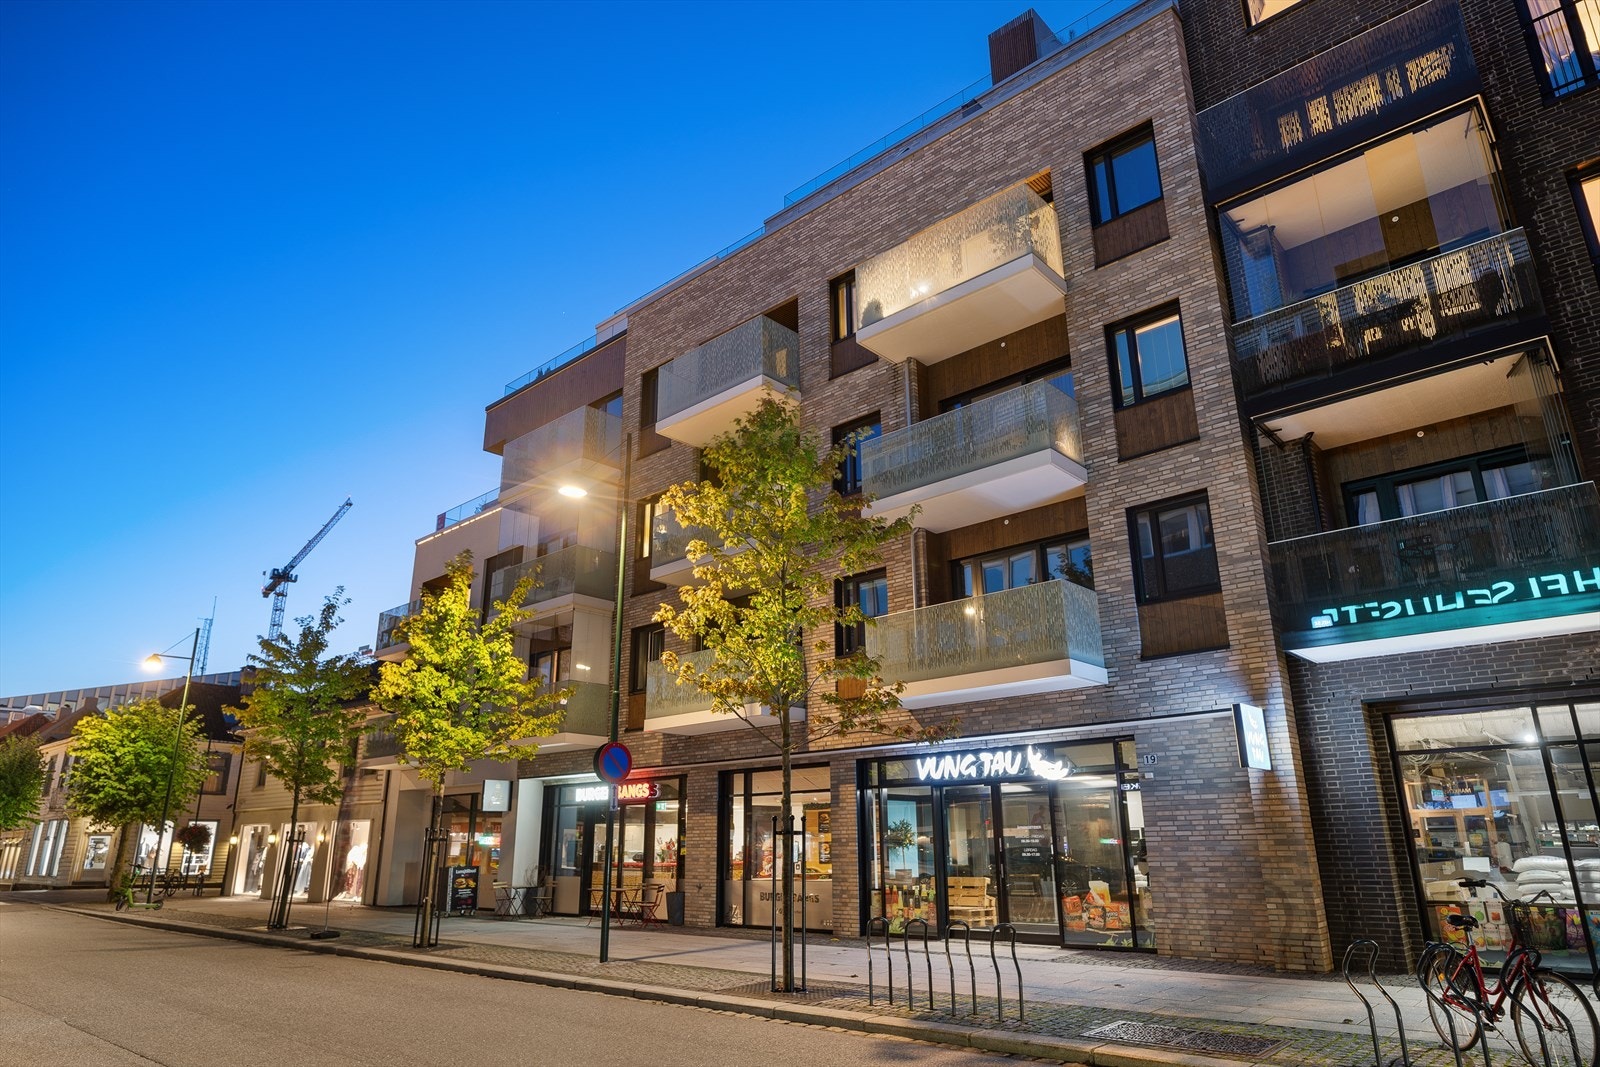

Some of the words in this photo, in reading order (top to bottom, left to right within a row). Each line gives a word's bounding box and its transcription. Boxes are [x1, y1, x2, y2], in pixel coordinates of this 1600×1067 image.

[916, 754, 977, 781] VUNG
[979, 750, 1023, 777] TAU
[1145, 755, 1156, 764] 19
[575, 785, 609, 802] BURGE
